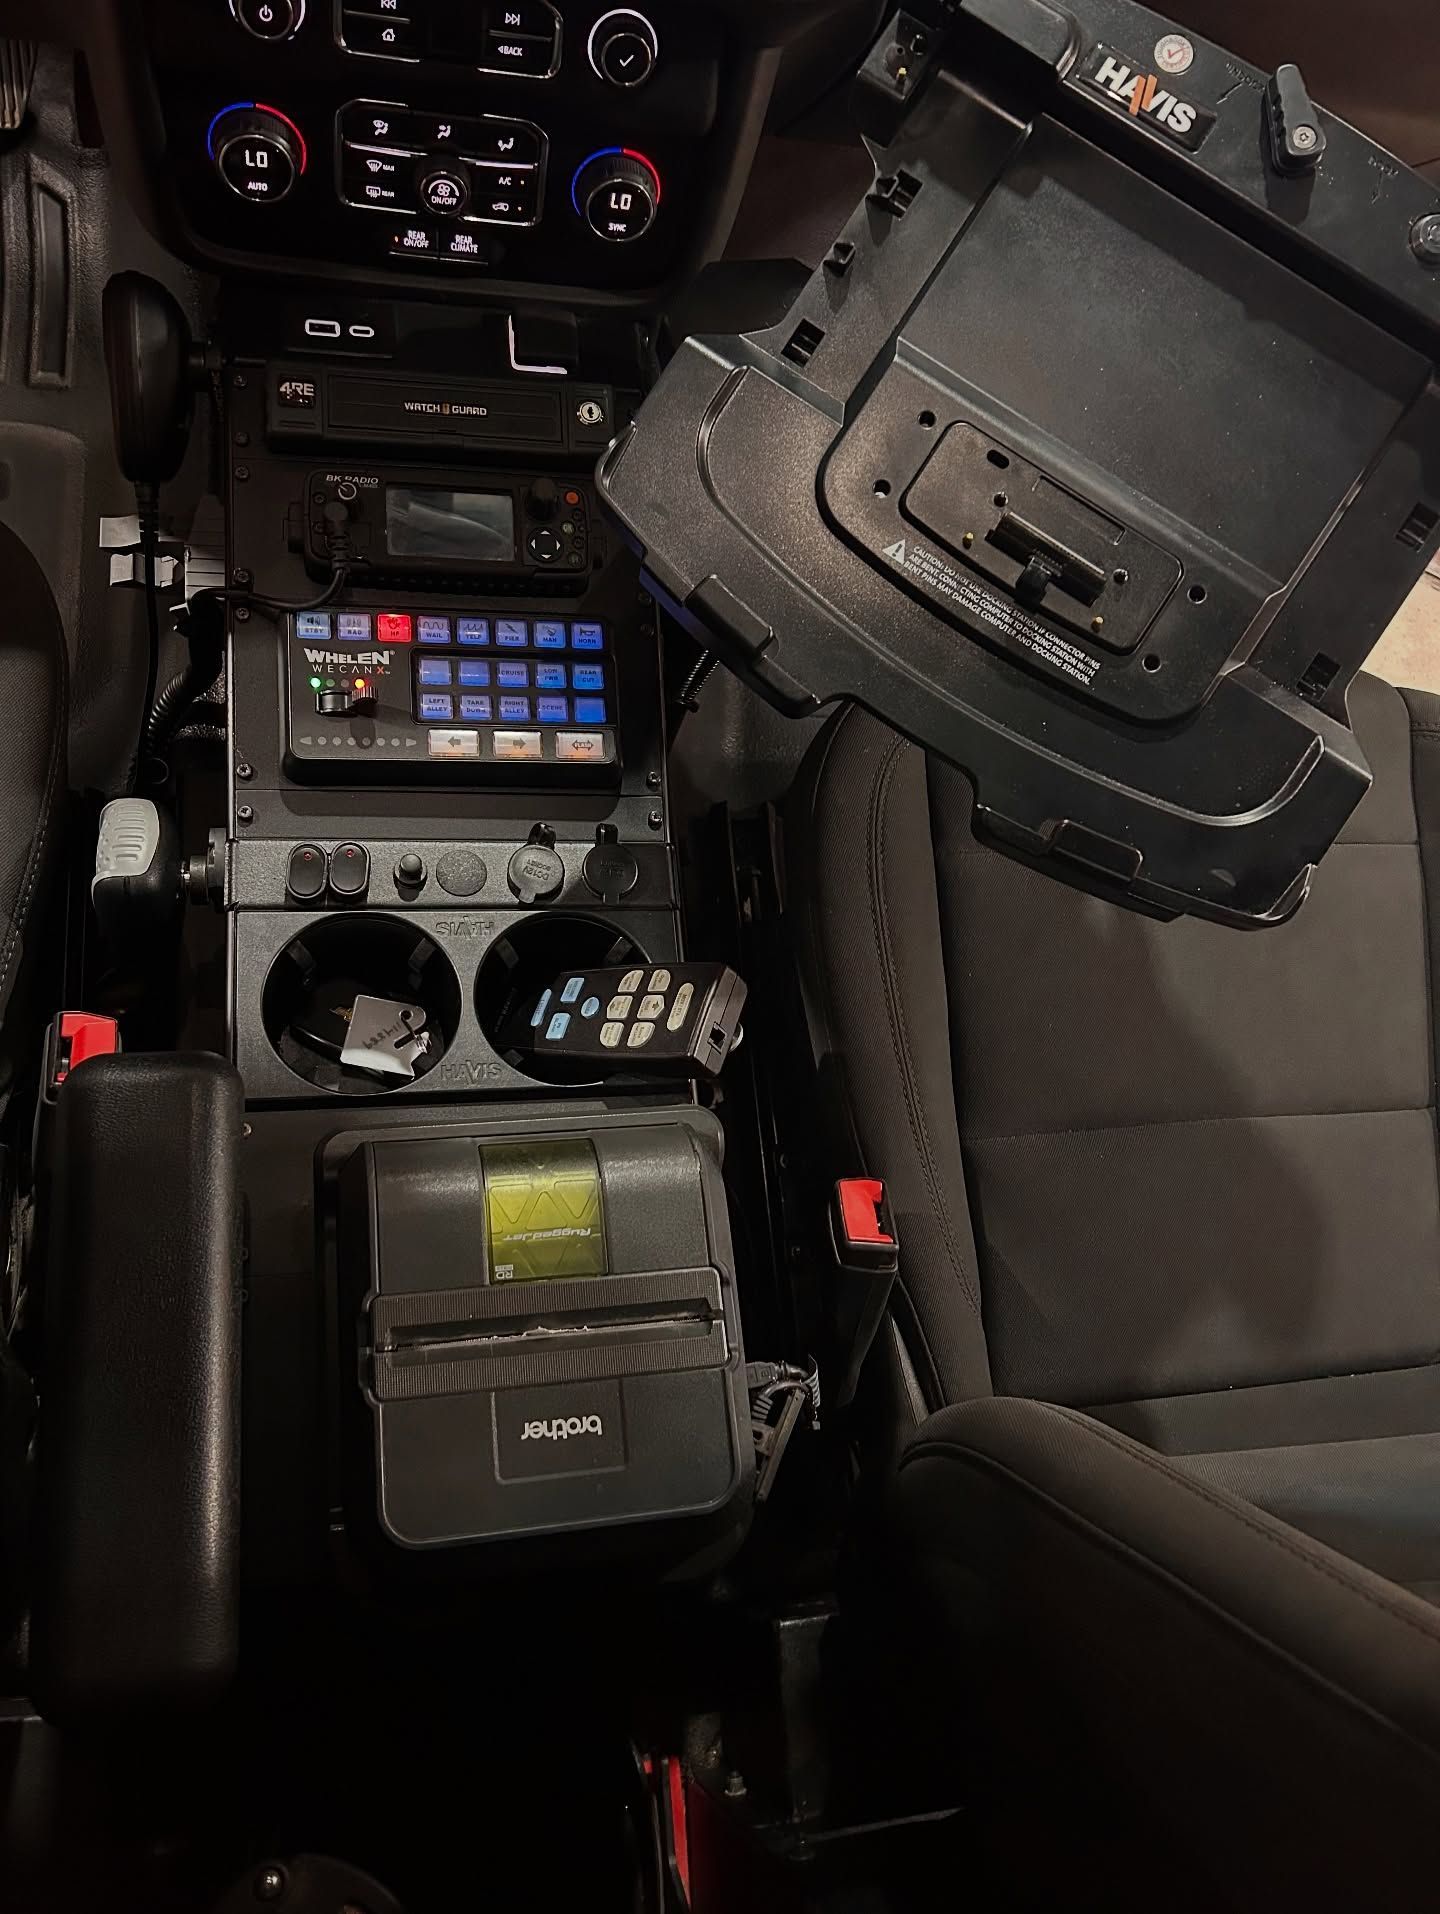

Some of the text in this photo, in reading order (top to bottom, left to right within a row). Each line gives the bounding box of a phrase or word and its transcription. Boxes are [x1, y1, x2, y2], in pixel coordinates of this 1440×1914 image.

[503, 45, 523, 56] BACK
[1094, 56, 1197, 134] HAVIS
[245, 149, 268, 168] LO
[247, 182, 268, 192] AUTO
[498, 176, 512, 186] A/C
[431, 195, 458, 206] ON/OFF
[609, 192, 632, 210] LO
[608, 222, 627, 233] SYNC
[407, 230, 426, 241] REAR
[455, 234, 473, 245] REAR
[403, 238, 429, 249] ON/OFF
[450, 242, 479, 254] CLIMATE
[404, 402, 488, 416] WATCH GUARD
[326, 474, 342, 482] BK
[903, 560, 923, 576] BENT
[921, 571, 938, 586] PINS
[936, 582, 953, 595] MAY
[951, 592, 982, 615] DAMAGE
[980, 610, 1017, 637] COMPUTER
[1015, 634, 1032, 646] AND
[1031, 643, 1063, 667] DOCKING
[908, 554, 923, 566] ARE
[979, 599, 1014, 625] COMPUTER
[1013, 620, 1023, 630] TO
[1022, 627, 1053, 649] DOCKING
[1051, 645, 1078, 666] STATION
[1076, 661, 1096, 677] WITH
[969, 582, 983, 594] USE
[981, 590, 1013, 614] DOCKING
[1011, 610, 1039, 631] STATION
[1045, 631, 1086, 660] CONNECTOR
[1084, 655, 1101, 670] PINS
[304, 648, 390, 665] WHELEN
[522, 866, 550, 881] DC12V
[435, 916, 494, 940] HAVIS
[440, 1057, 501, 1084] HAVIS
[496, 1271, 513, 1280] RD
[521, 1415, 603, 1440] brother
